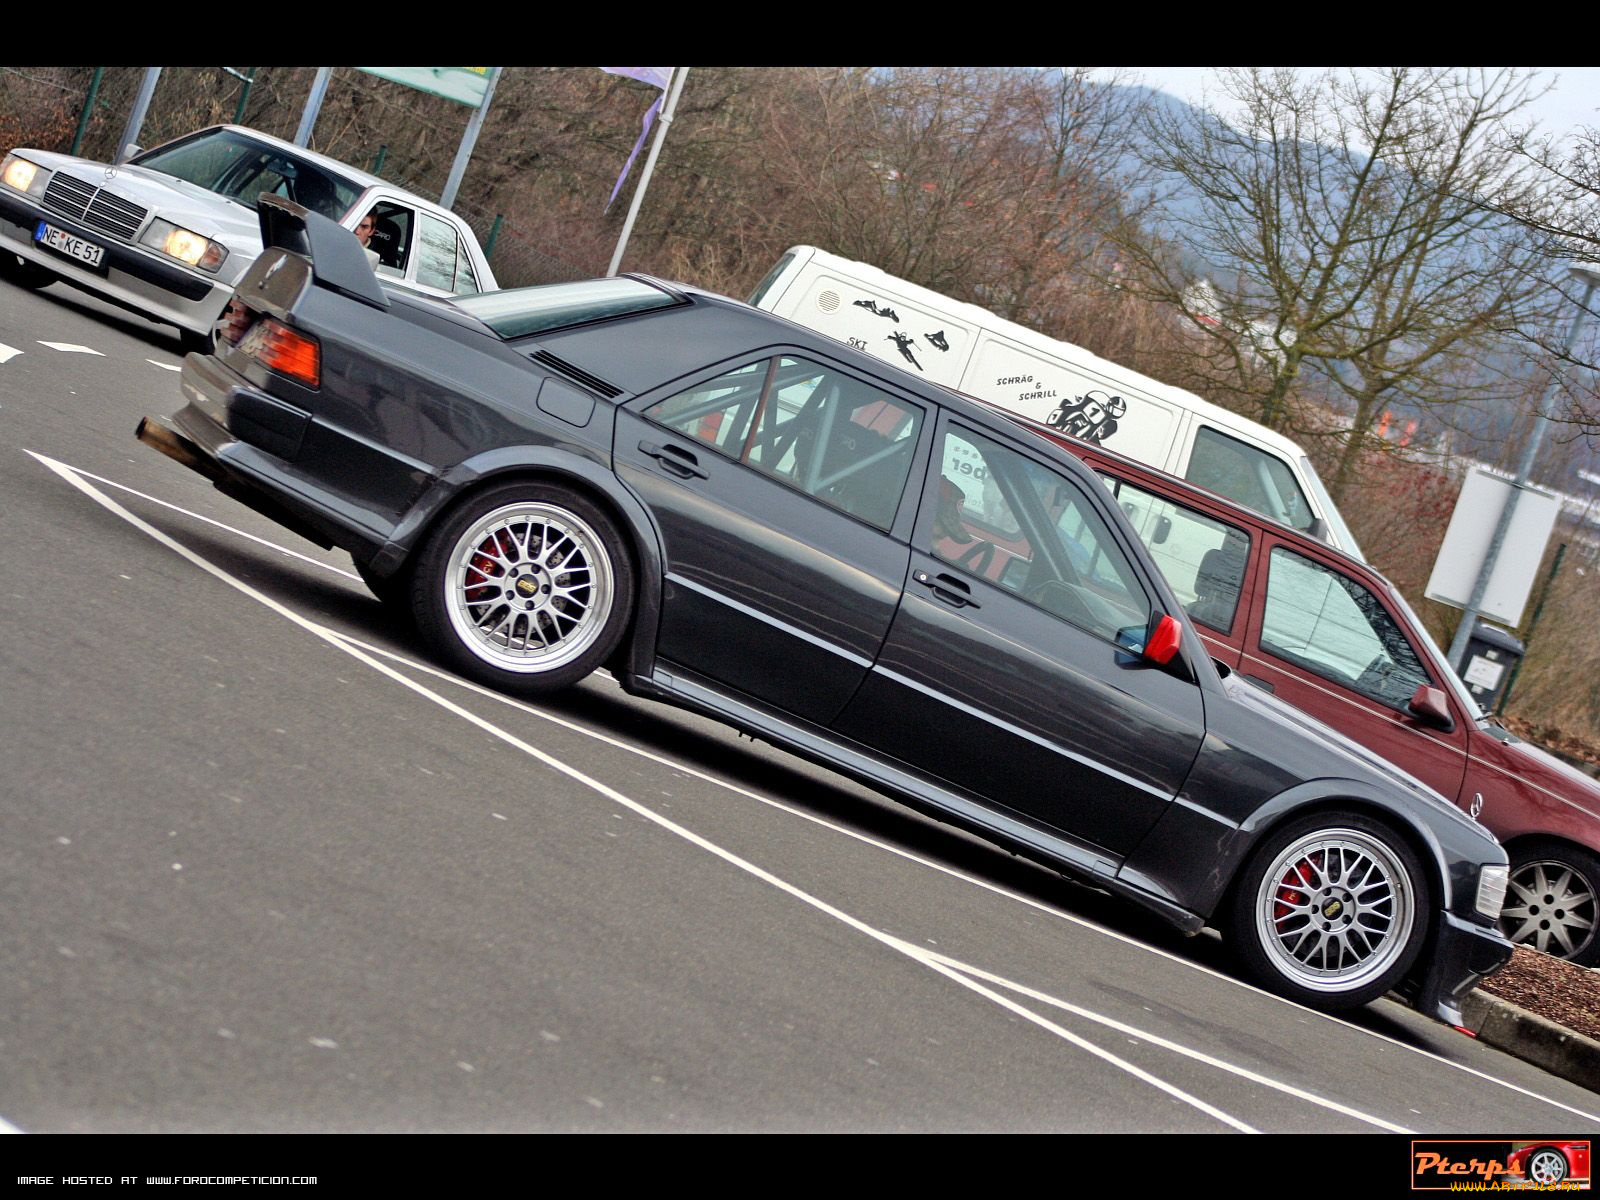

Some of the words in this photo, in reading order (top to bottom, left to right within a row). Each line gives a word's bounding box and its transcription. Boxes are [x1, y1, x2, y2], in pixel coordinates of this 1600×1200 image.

[42, 226, 60, 246] NE
[63, 236, 84, 257] KE
[82, 245, 101, 264] 51
[847, 336, 868, 352] SKI
[1035, 382, 1042, 390] &
[1019, 389, 1057, 401] SCHRILL
